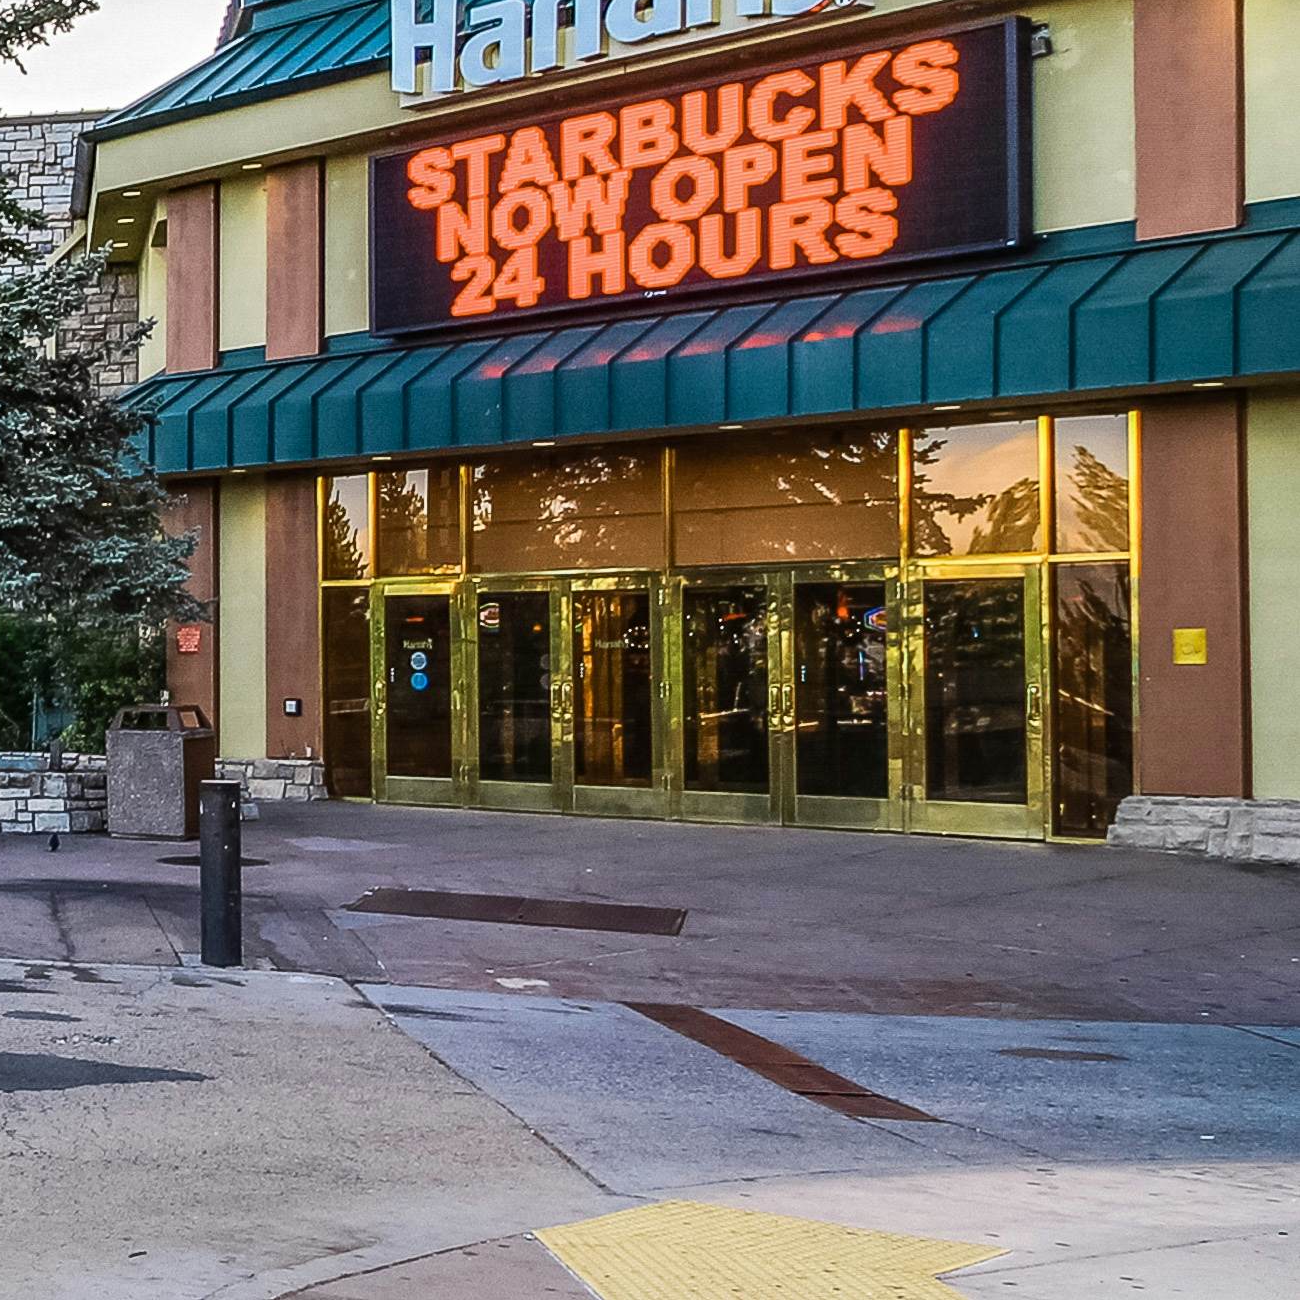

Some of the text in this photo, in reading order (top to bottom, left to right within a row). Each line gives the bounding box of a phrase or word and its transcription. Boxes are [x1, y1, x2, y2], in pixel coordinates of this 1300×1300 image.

[406, 38, 960, 210] STARBUCKS
[435, 115, 914, 263] NOW OPEN
[450, 186, 899, 317] 24 HOURS
